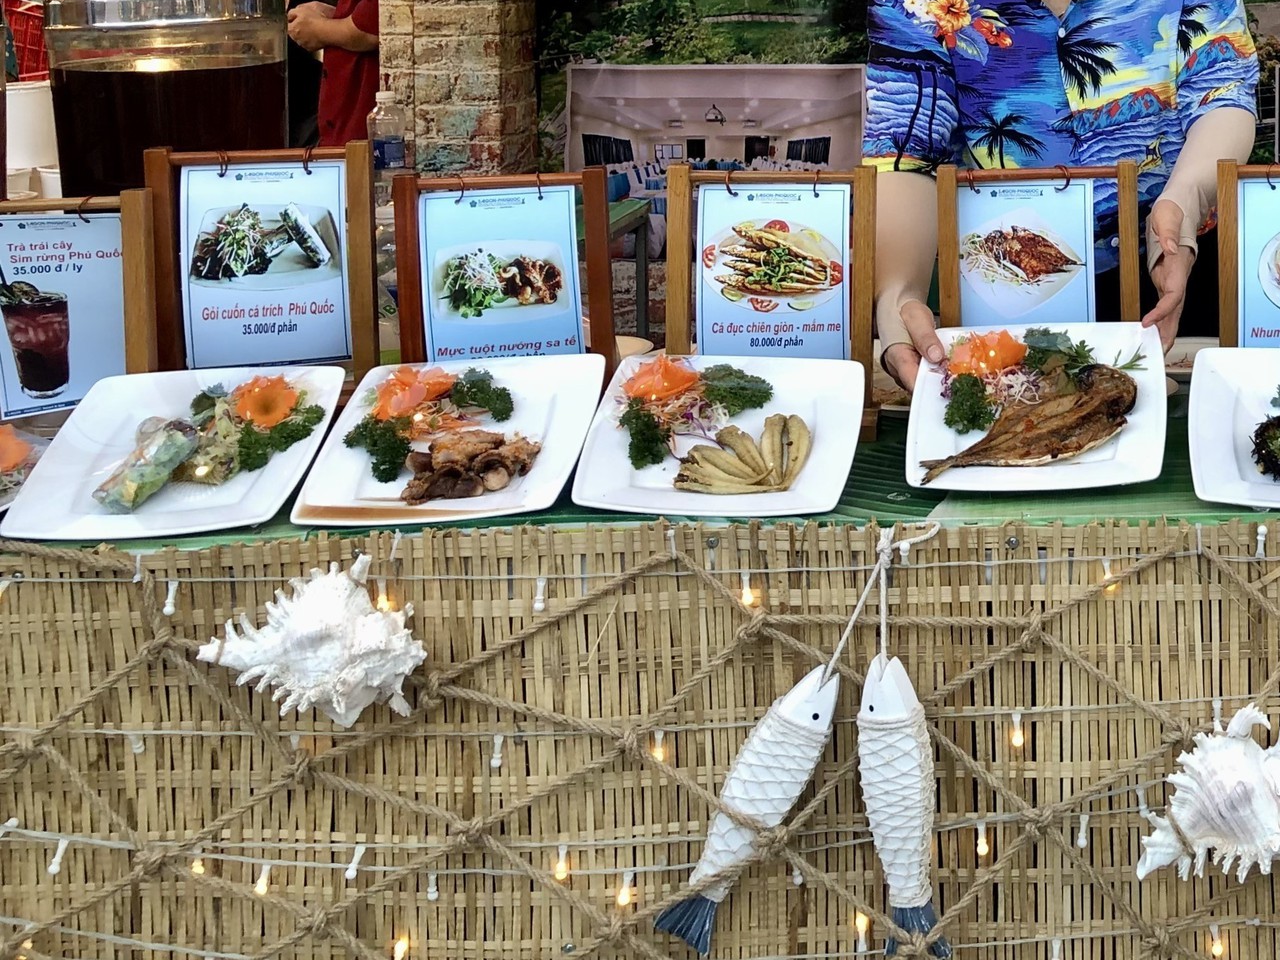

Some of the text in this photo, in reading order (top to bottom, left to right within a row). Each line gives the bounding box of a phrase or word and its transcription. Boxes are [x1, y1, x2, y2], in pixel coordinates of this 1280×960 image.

[7, 241, 73, 252] Trà trái cây
[10, 248, 122, 263] Sim rừng Phú Quố
[13, 264, 51, 275] 35.000
[55, 264, 62, 272] đ
[73, 263, 83, 273] ly
[202, 298, 335, 320] Gỏi cuốn cá trích Phú Quốc
[242, 319, 298, 335] 35.000/đ phần
[712, 321, 724, 333] Cá
[727, 322, 743, 336] đục
[746, 321, 771, 333] chiên
[774, 322, 794, 335] giòn
[802, 319, 824, 332] mắm
[827, 323, 841, 332] me
[437, 347, 465, 358] Mực
[470, 343, 495, 355] tuột
[499, 340, 542, 352] nướng
[546, 339, 560, 348] sa
[565, 335, 577, 346] tế
[750, 335, 804, 348] 80.000/đ phần
